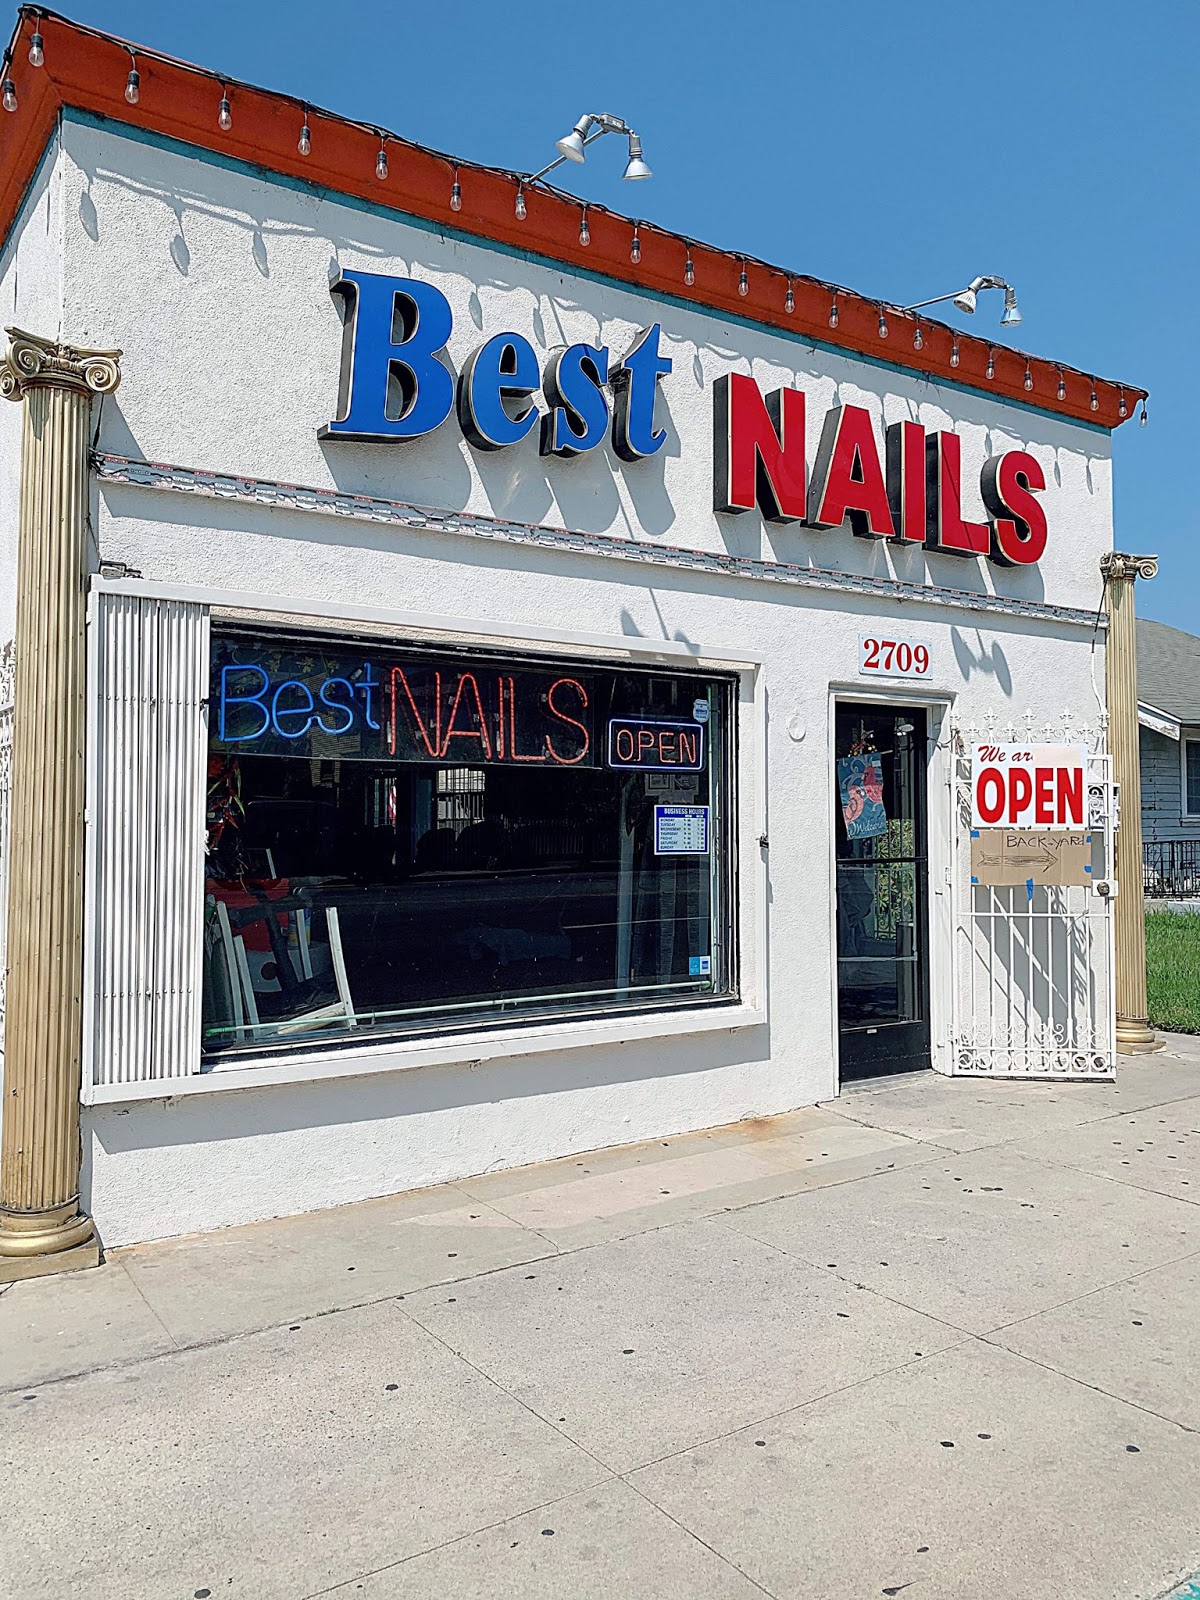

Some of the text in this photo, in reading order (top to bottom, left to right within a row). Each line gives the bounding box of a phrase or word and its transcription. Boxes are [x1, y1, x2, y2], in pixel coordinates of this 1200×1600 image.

[323, 268, 1048, 567] Best NAILS
[863, 638, 929, 674] 2709
[218, 662, 591, 765] Best NAILS
[616, 729, 697, 764] OPEN
[977, 745, 1034, 763] We ar
[976, 767, 1084, 824] OPEN
